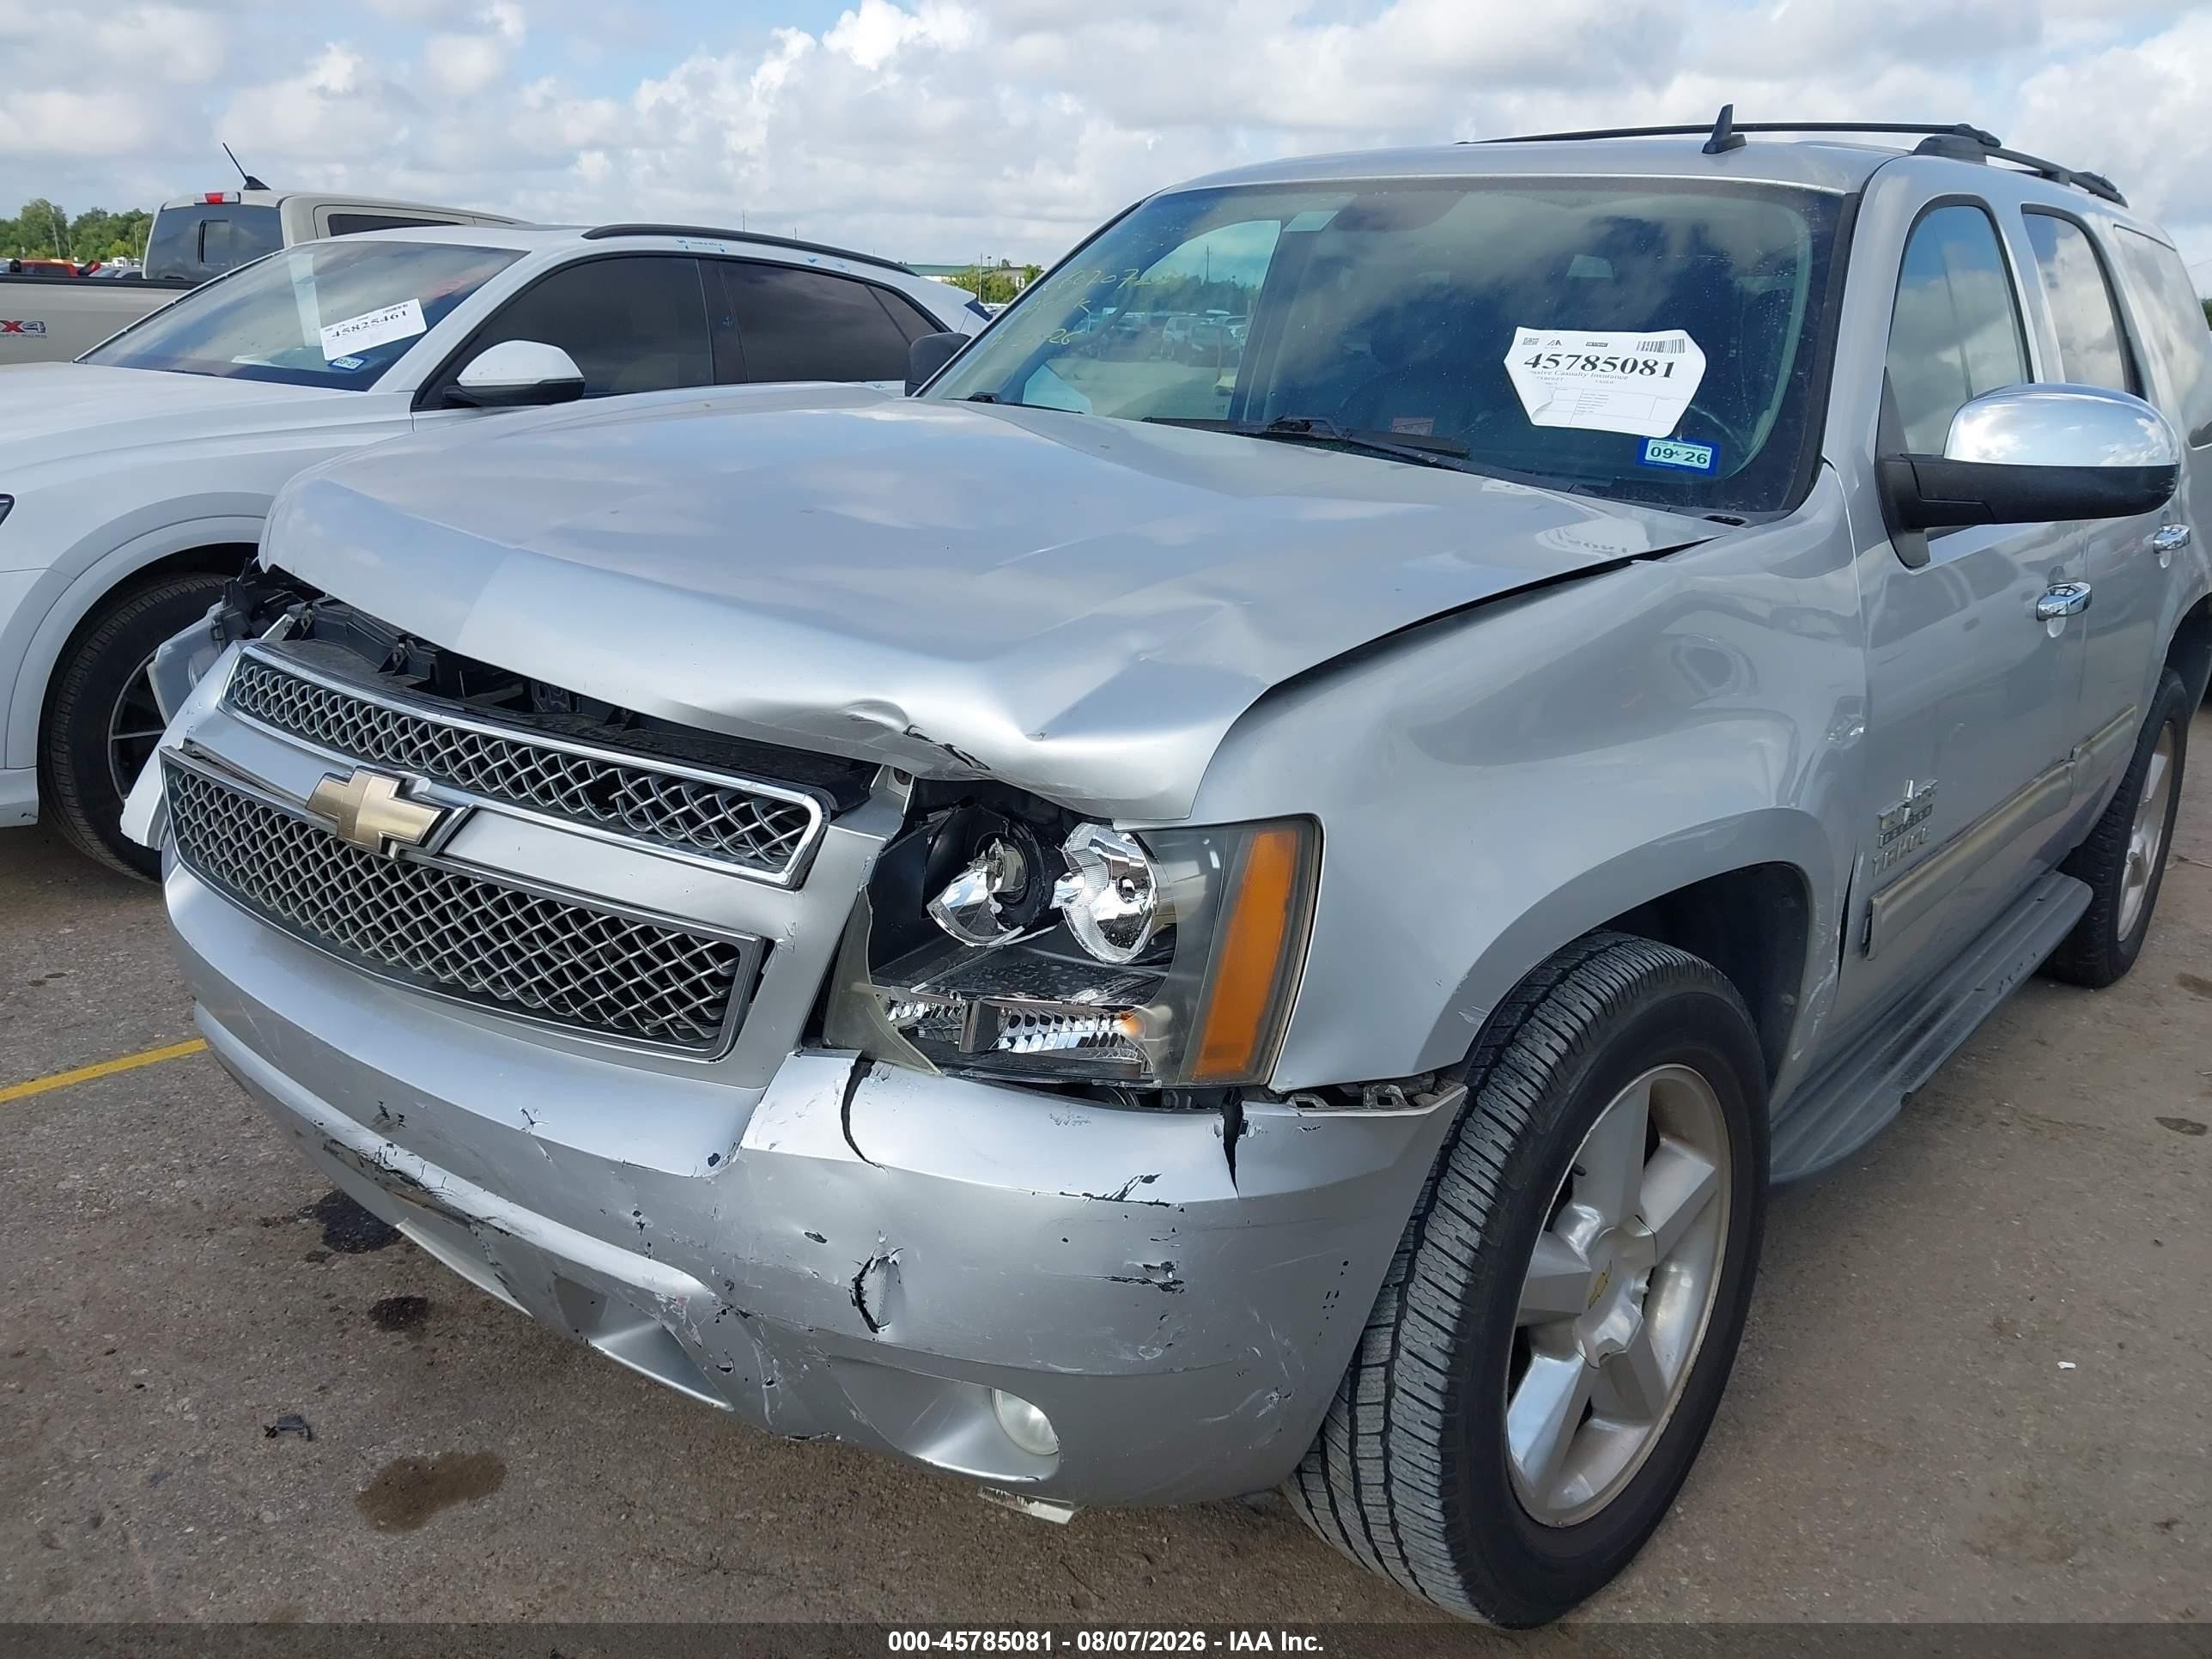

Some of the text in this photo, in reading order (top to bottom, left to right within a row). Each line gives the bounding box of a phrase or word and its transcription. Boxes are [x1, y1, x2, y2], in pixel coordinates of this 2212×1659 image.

[0, 319, 46, 333] X4
[331, 310, 406, 337] 45825461
[1523, 352, 1676, 379] 45785081
[1591, 372, 1630, 381] Insurance
[1650, 447, 1674, 459] 09
[1683, 451, 1708, 465] 26
